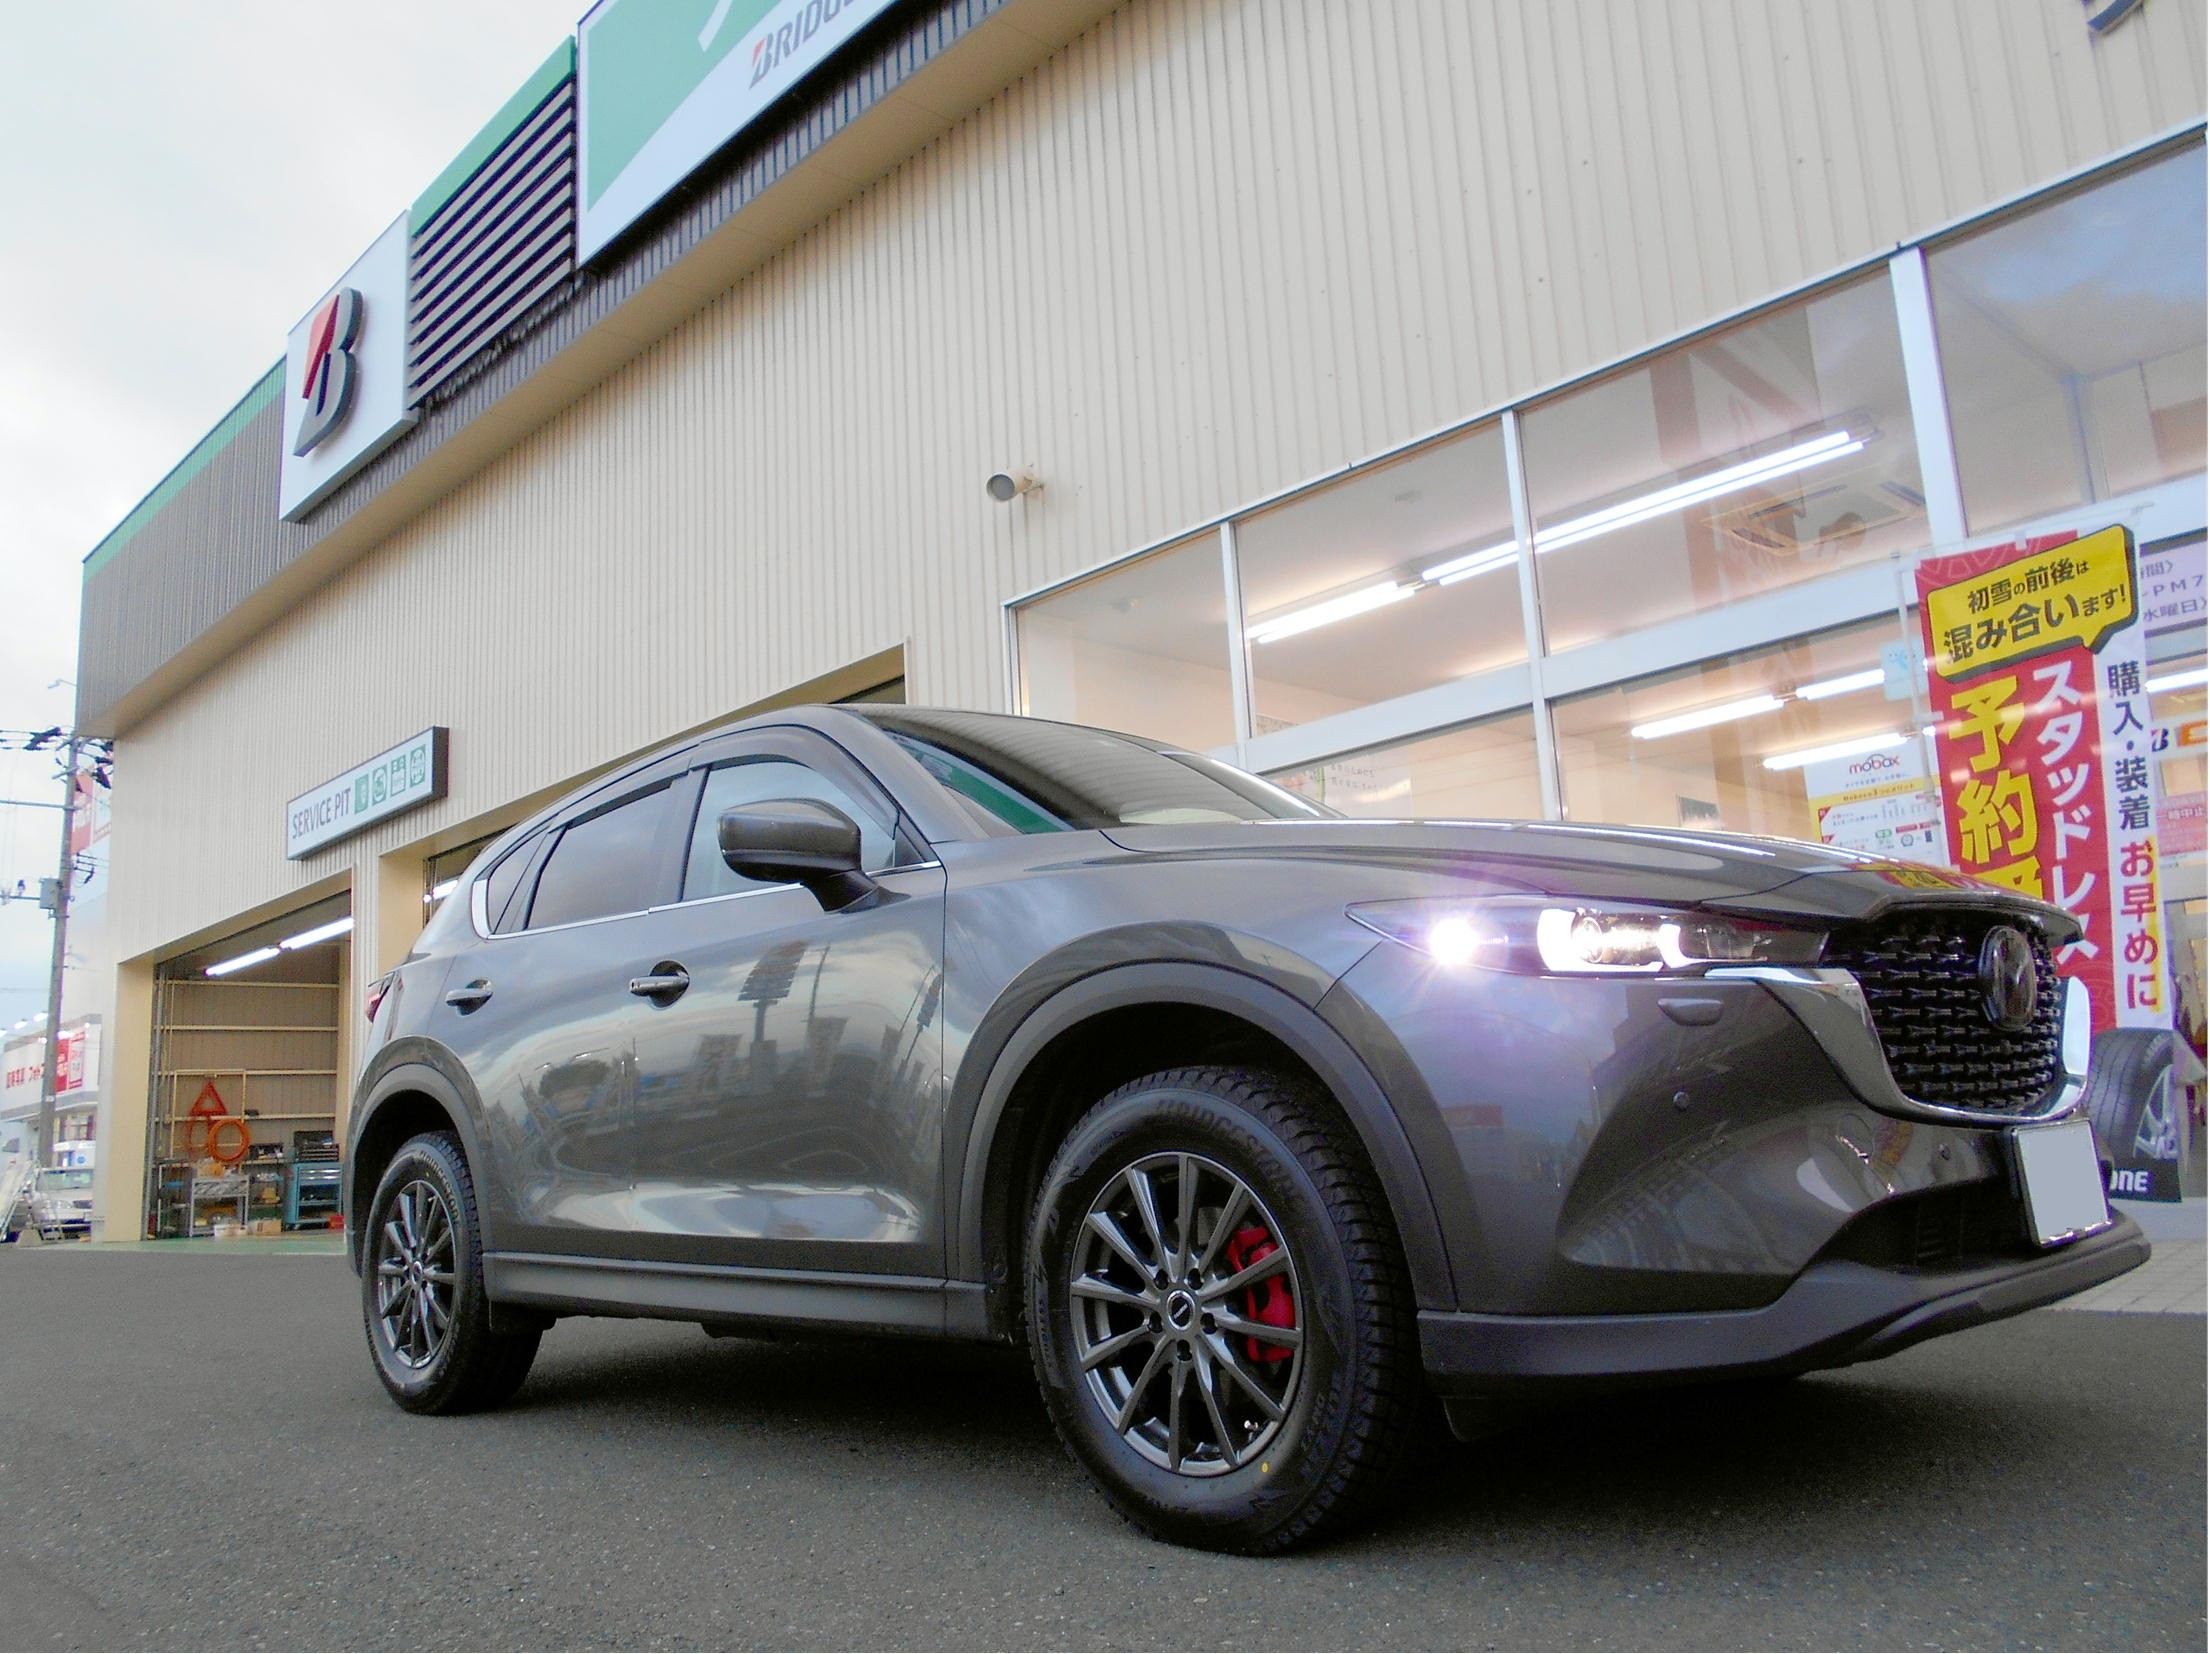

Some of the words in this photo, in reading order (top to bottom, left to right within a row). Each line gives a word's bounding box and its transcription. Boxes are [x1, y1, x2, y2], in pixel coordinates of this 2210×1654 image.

[1967, 557, 2090, 615] 初雪の前後は
[1943, 583, 2127, 664] 混み合います!
[292, 796, 332, 839] SERVICE
[334, 787, 352, 821] PIT
